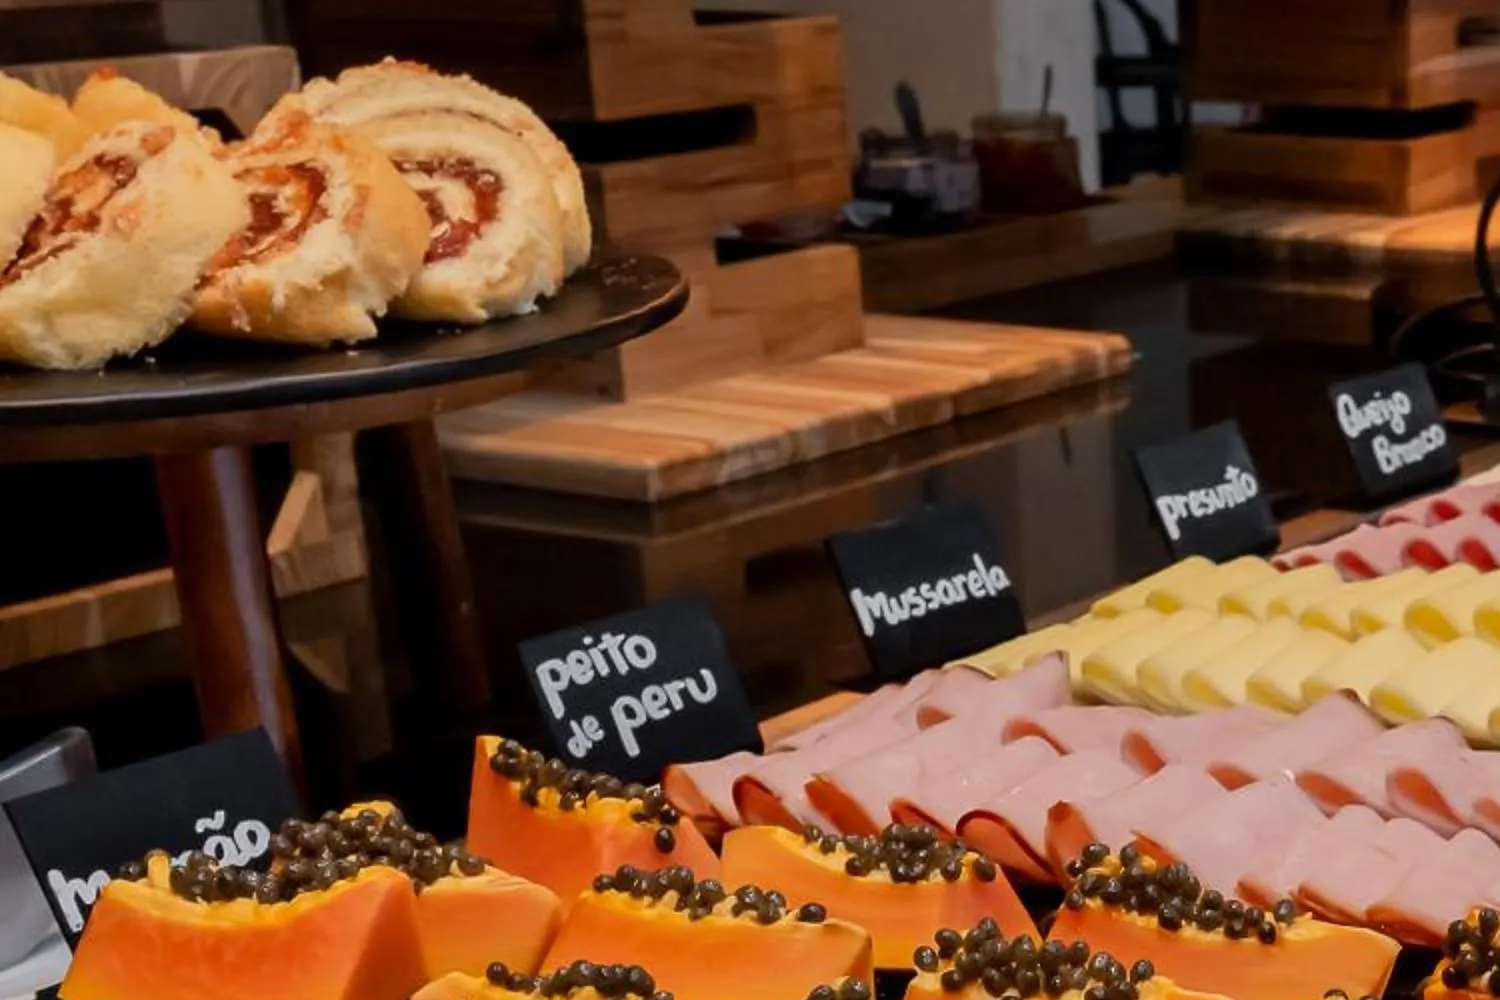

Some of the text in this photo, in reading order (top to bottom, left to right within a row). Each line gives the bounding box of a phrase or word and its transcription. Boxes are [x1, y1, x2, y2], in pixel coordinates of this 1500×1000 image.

[1372, 423, 1446, 474] Branco
[1156, 464, 1258, 541] presunto
[850, 553, 1011, 637] Mussarela
[536, 632, 657, 719] peito
[567, 668, 718, 758] de peru
